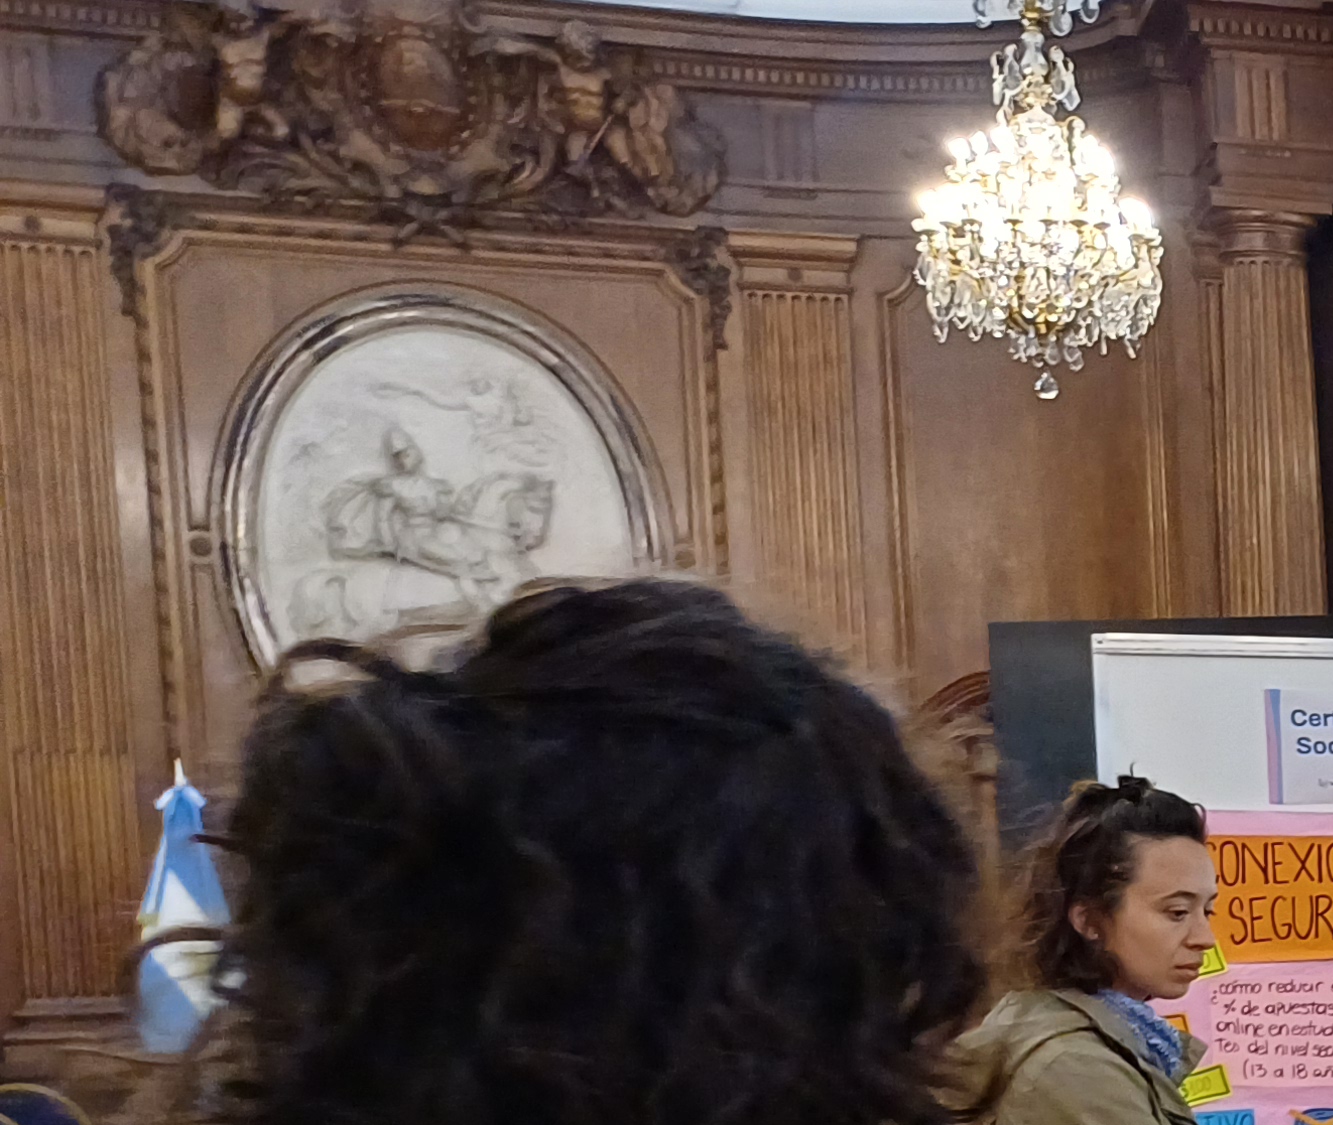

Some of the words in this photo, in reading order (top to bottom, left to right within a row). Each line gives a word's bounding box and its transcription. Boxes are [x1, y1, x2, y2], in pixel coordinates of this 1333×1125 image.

[1241, 1001, 1260, 1016] de
[1216, 1019, 1264, 1037] online
[1248, 1040, 1268, 1055] del
[1274, 1066, 1284, 1077] a
[1292, 1064, 1308, 1079] 18
